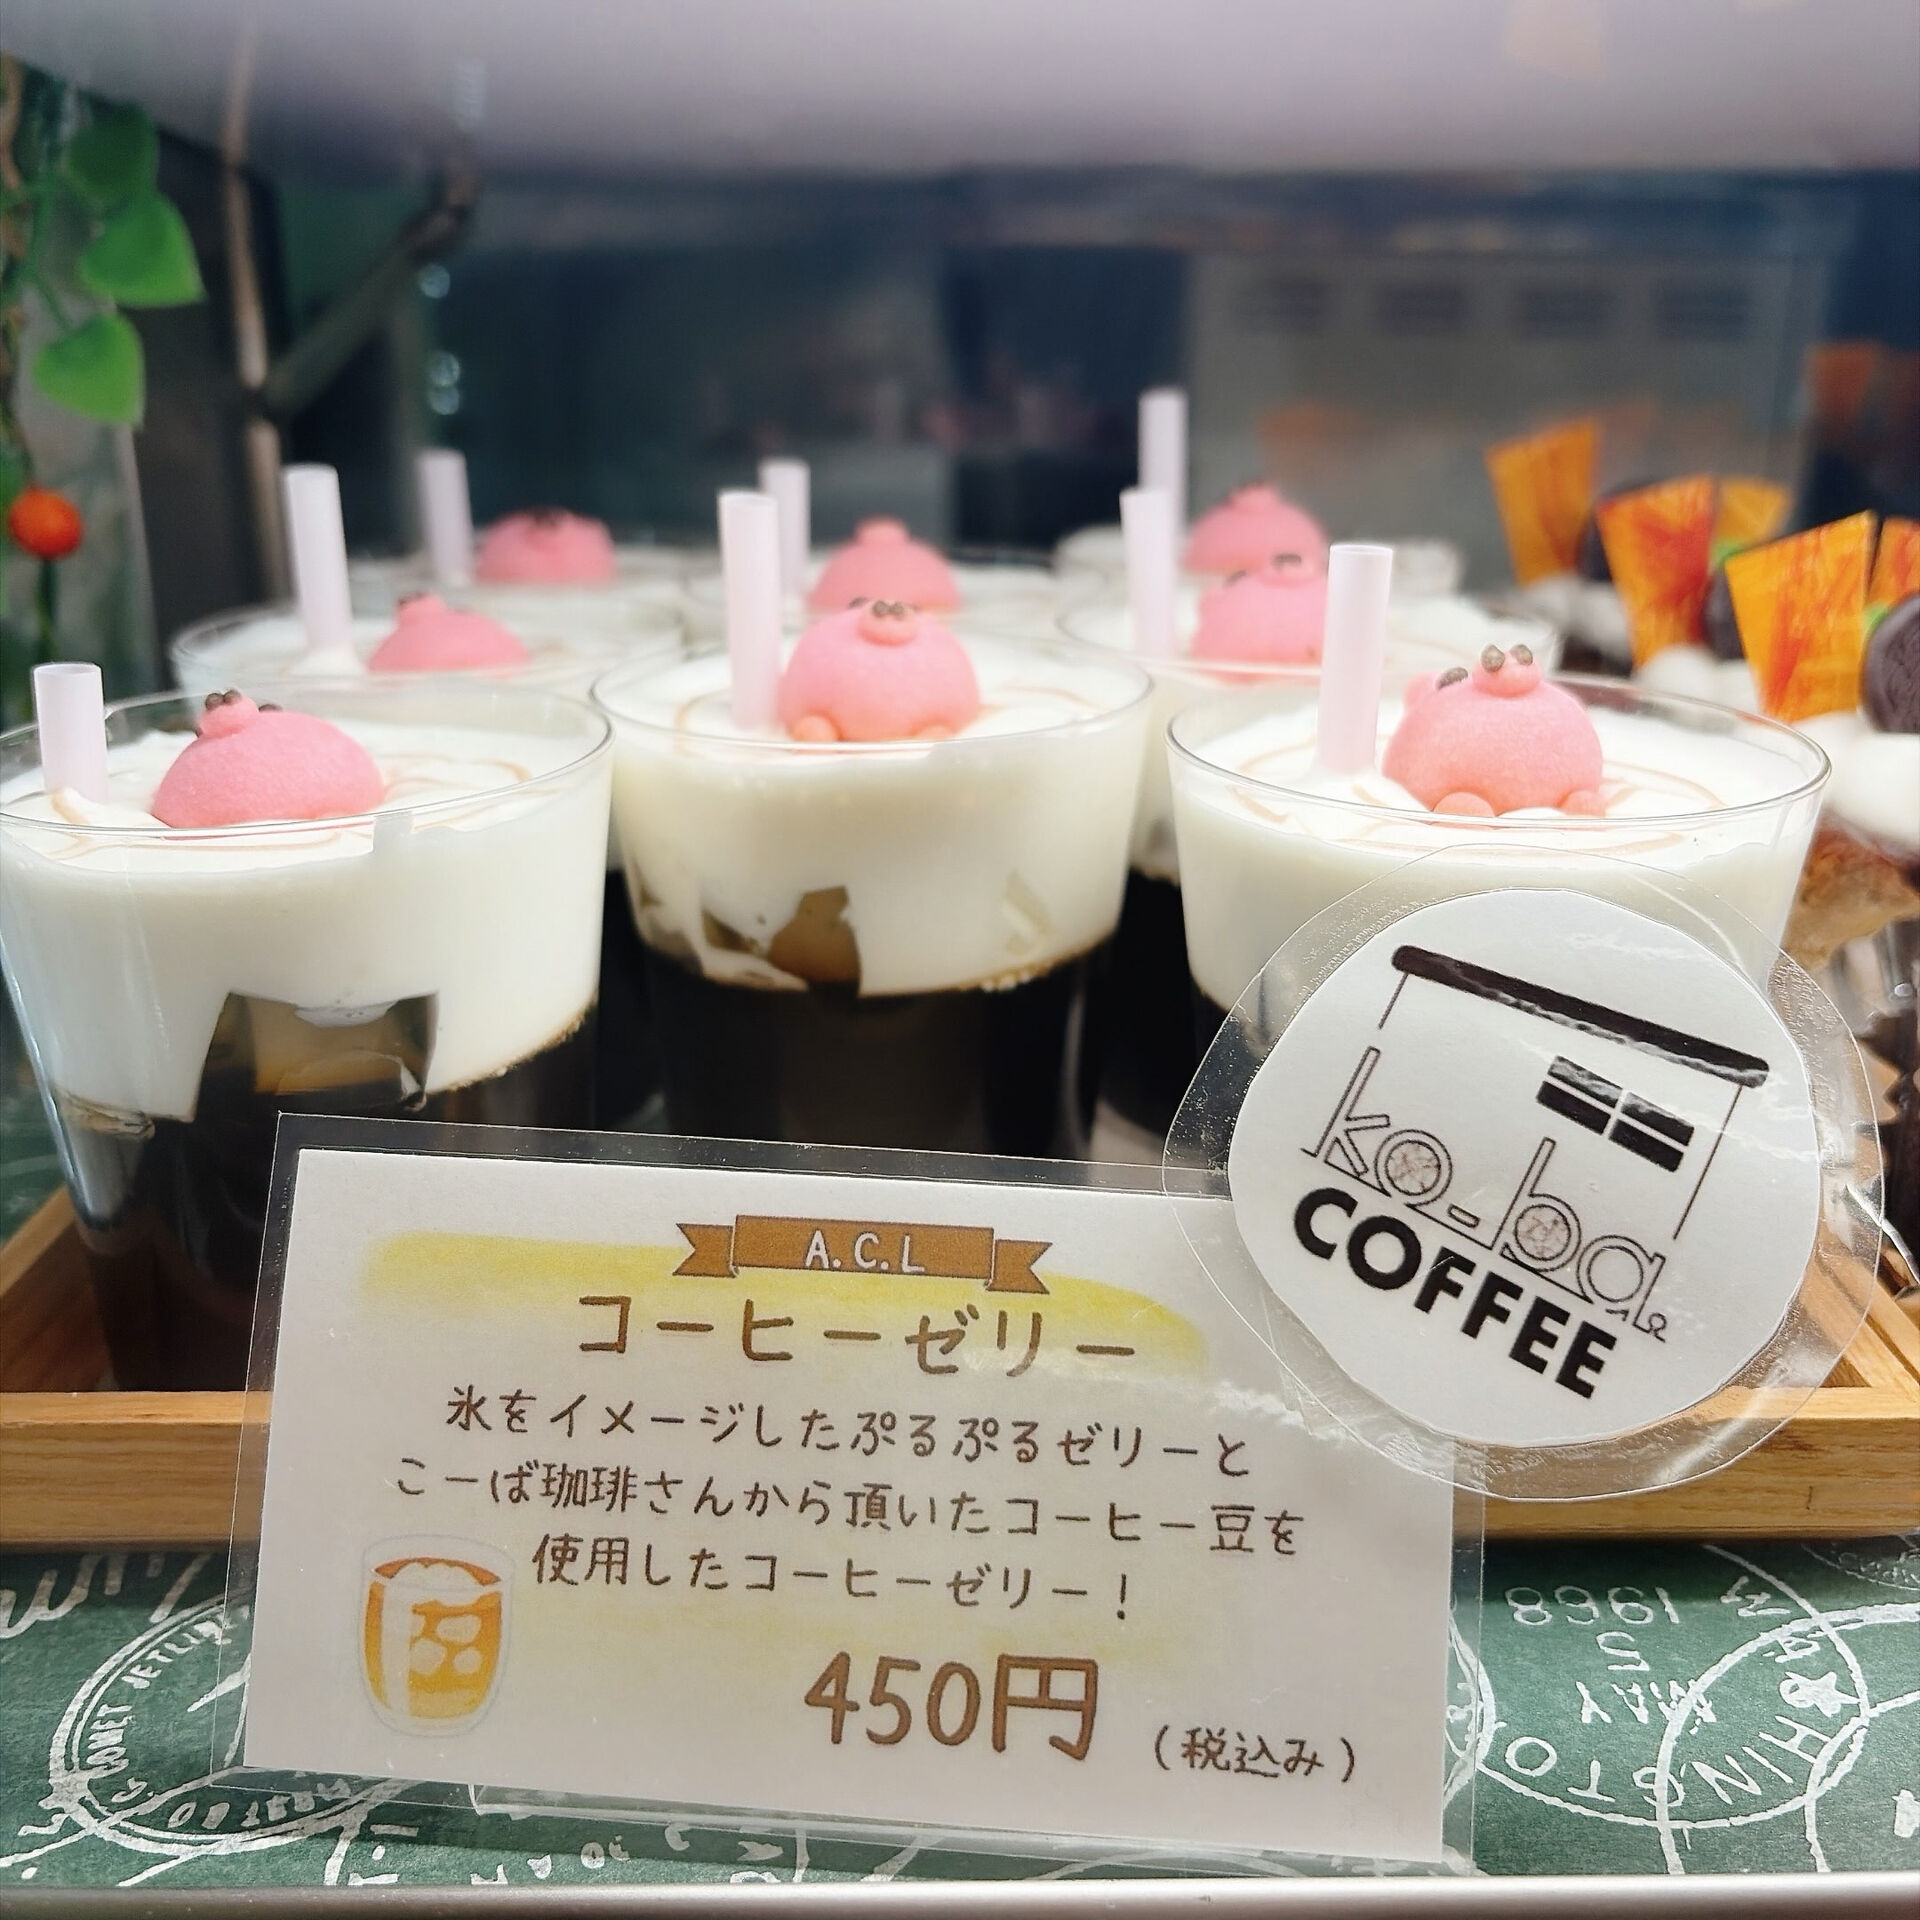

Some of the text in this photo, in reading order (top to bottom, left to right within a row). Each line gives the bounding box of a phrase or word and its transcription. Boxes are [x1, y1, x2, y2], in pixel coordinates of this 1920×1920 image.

[804, 1230, 926, 1274] A.C.L
[1293, 1186, 1618, 1400] COFFEE
[578, 1294, 1136, 1377] コーヒーゼリー
[445, 1383, 1251, 1479] 氷をイメージしたぷるぷるゼリーと
[396, 1457, 1305, 1556] こーば珈琲さんから頂いたコーヒー豆を
[1503, 1584, 1681, 1627] 1968
[803, 1650, 1099, 1762] 450円
